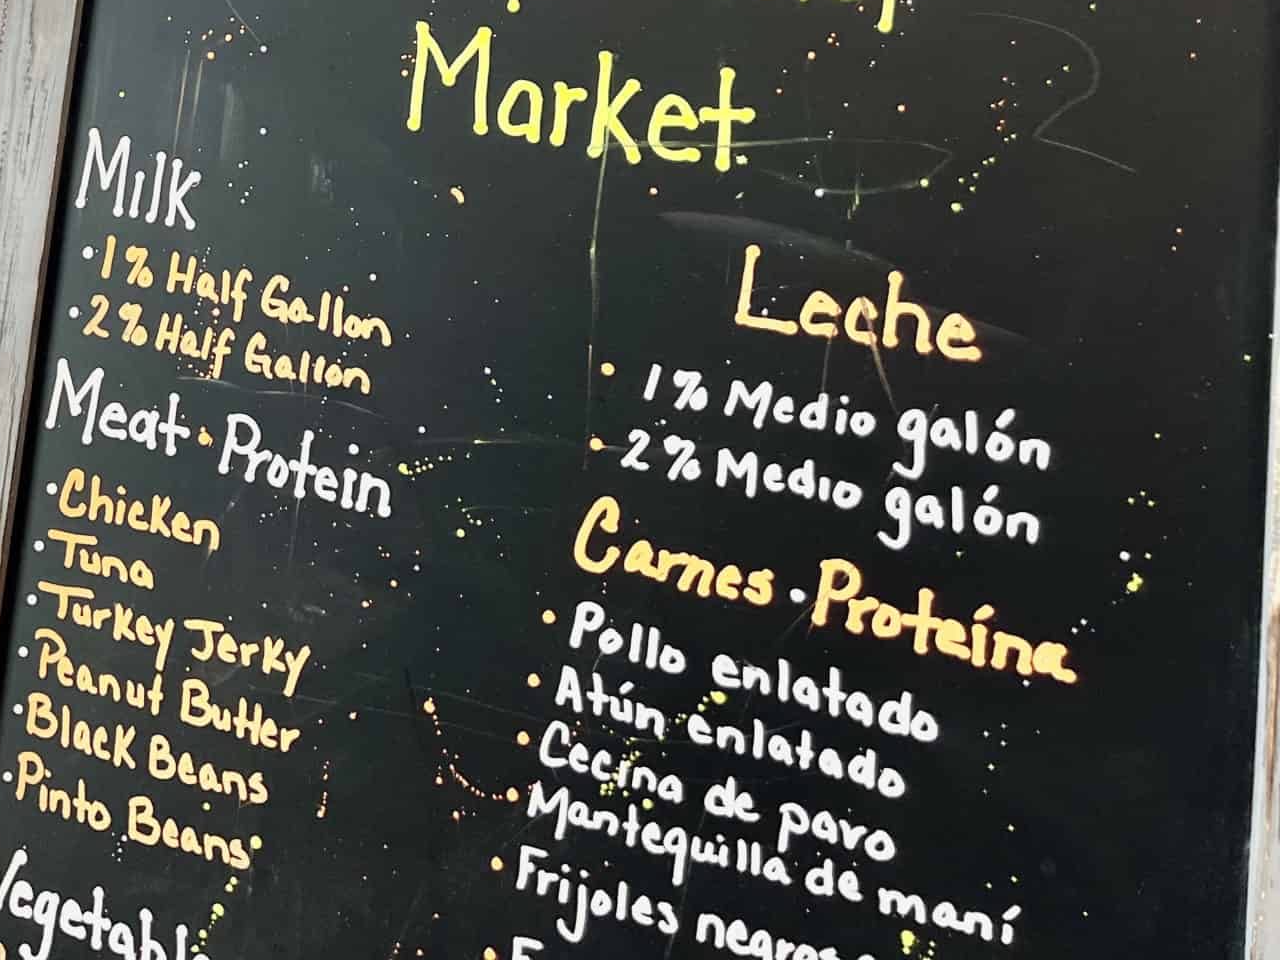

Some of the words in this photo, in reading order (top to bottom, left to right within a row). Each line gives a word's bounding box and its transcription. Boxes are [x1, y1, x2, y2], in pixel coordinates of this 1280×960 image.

[407, 21, 756, 171] Market
[75, 128, 201, 229] Milk
[155, 313, 235, 378] Half
[245, 332, 370, 394] Gallon
[166, 251, 253, 322] Half
[261, 274, 392, 347] Gallon
[735, 245, 982, 361] Leche
[46, 359, 191, 456] Meat
[218, 413, 391, 518] Protein
[724, 380, 875, 436] Medio
[892, 407, 1050, 479] galón
[58, 468, 220, 550] Chicken
[715, 448, 862, 509] Medio
[878, 485, 1039, 550] galón
[48, 529, 154, 590] Tuna
[38, 580, 174, 671] Turkey
[184, 619, 311, 697] Jerky
[569, 601, 686, 674] Pollo
[711, 653, 939, 743] enlatado
[810, 558, 1078, 682] Proteína
[34, 629, 164, 715] Peanut
[180, 678, 300, 752] Butter
[554, 666, 665, 737] Atún
[687, 713, 905, 797] enlatado
[25, 693, 135, 769] Black
[148, 734, 267, 804] Beans
[539, 720, 683, 803] Cecina
[704, 777, 760, 822] de
[15, 751, 112, 831] Pinto
[127, 795, 251, 870] Beans
[527, 787, 791, 885] Mantequilla
[805, 860, 863, 901] de
[877, 888, 1021, 945] maní
[516, 845, 679, 942] Frijoles
